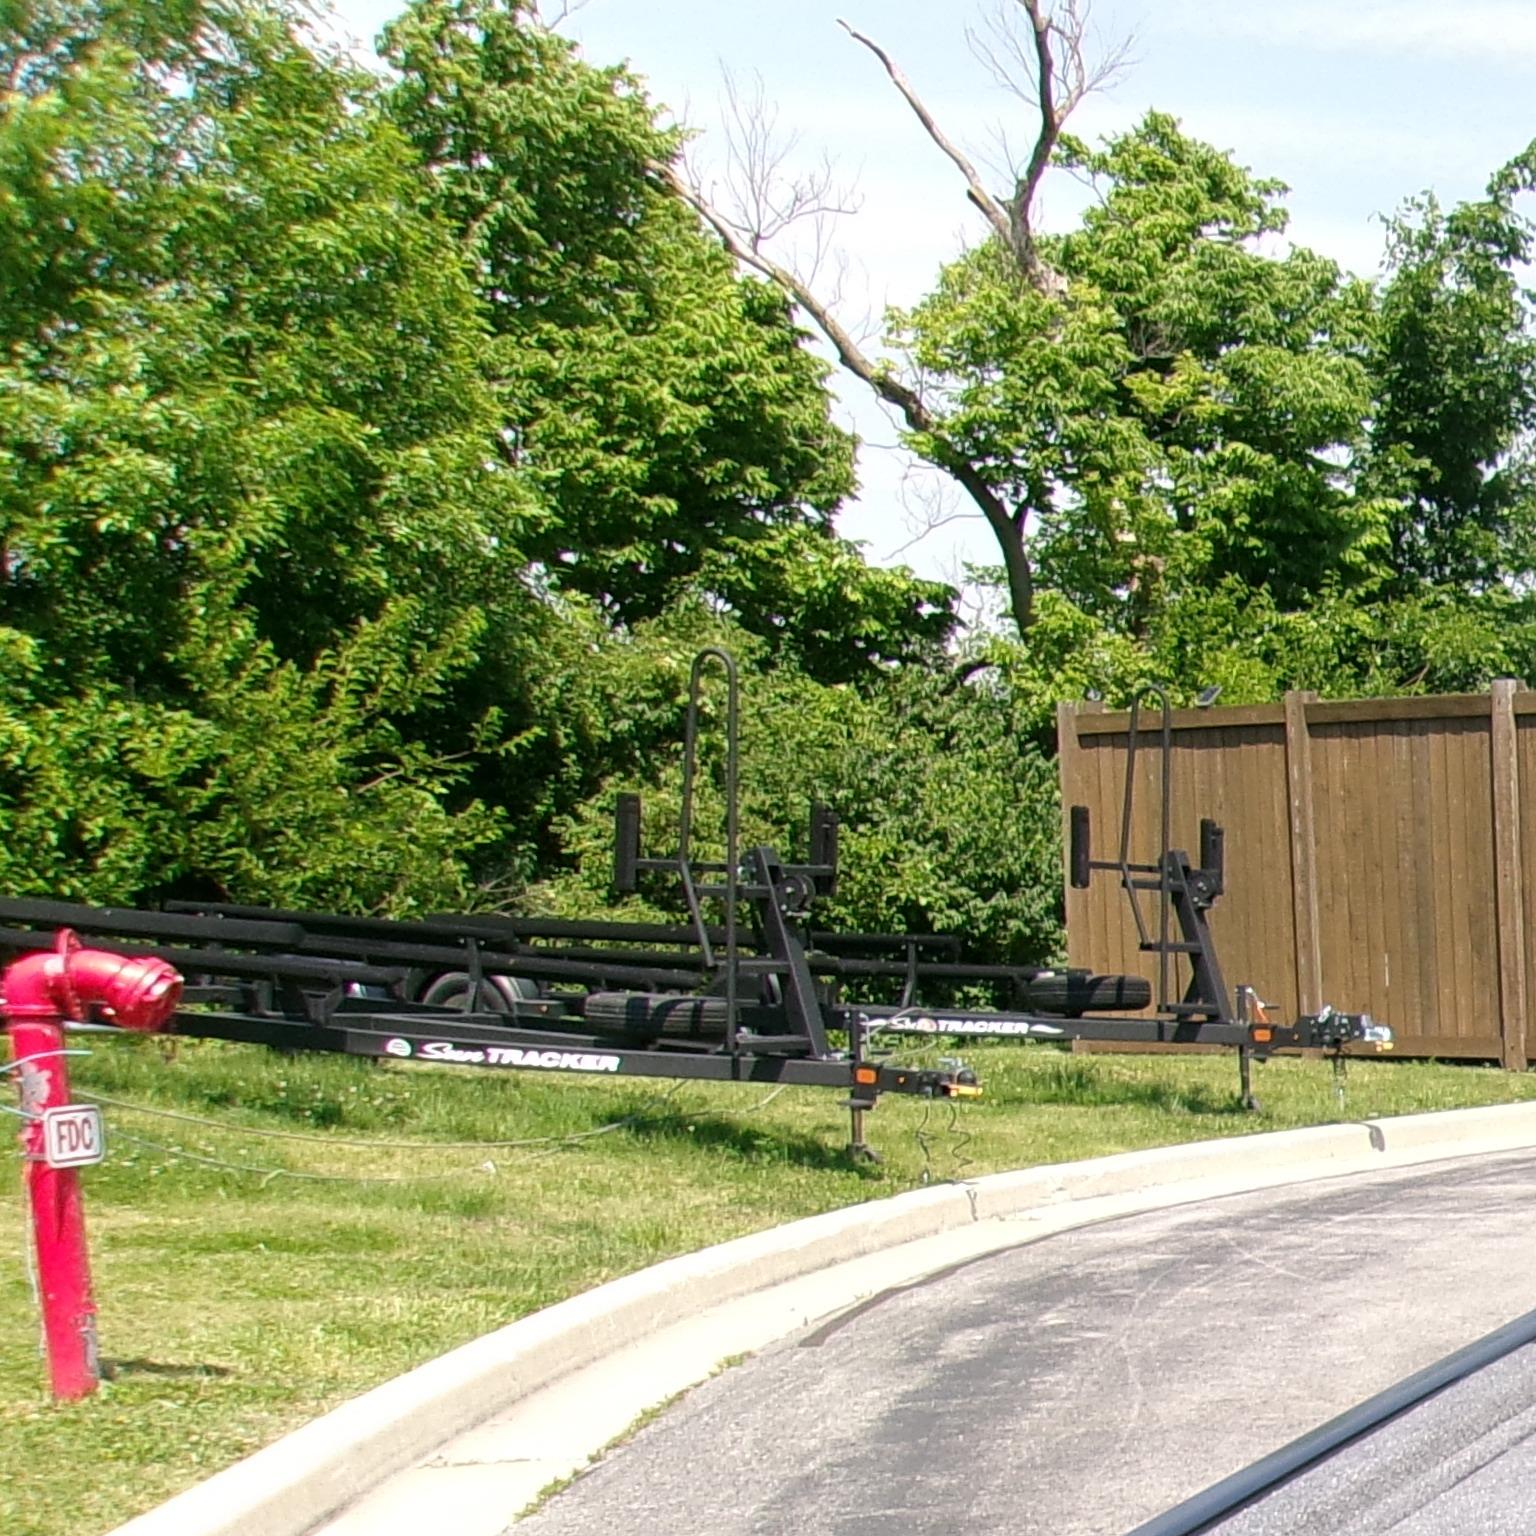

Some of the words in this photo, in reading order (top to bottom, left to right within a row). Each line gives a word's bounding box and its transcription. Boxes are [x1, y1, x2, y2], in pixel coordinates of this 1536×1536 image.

[937, 1019, 1030, 1034] TRACKER
[417, 1042, 486, 1063] Sun
[485, 1047, 621, 1072] TRACKER
[56, 1116, 95, 1154] FDC
